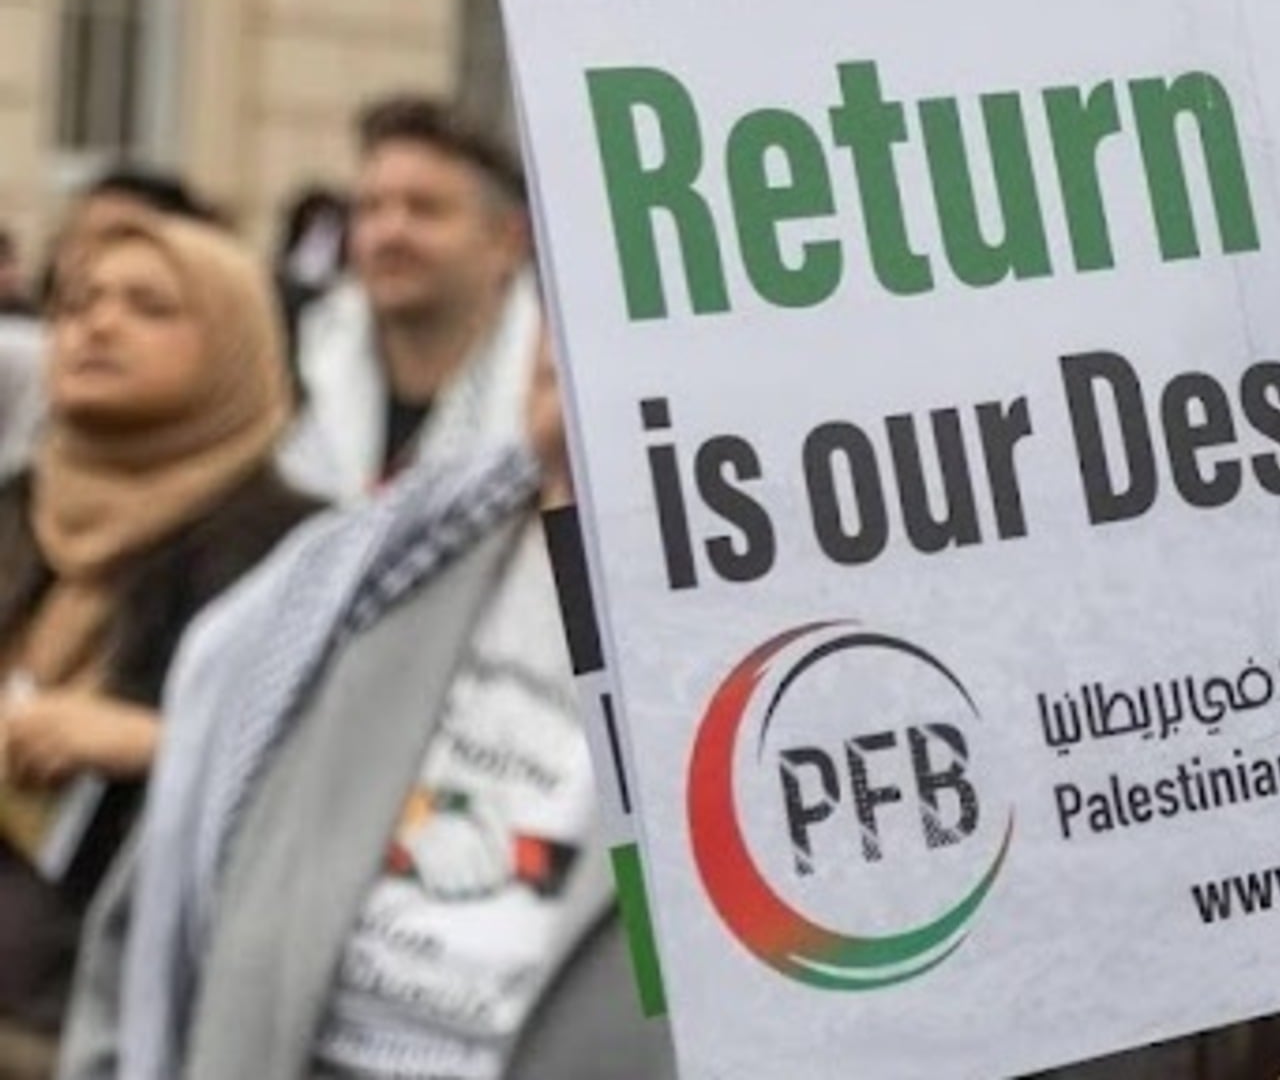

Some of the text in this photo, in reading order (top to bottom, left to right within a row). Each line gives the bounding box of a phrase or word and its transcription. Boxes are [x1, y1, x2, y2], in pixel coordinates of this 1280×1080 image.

[585, 58, 1261, 321] Return
[639, 397, 777, 591] is
[801, 394, 1032, 568] our
[1186, 657, 1274, 735] في
[779, 722, 981, 876] PFB
